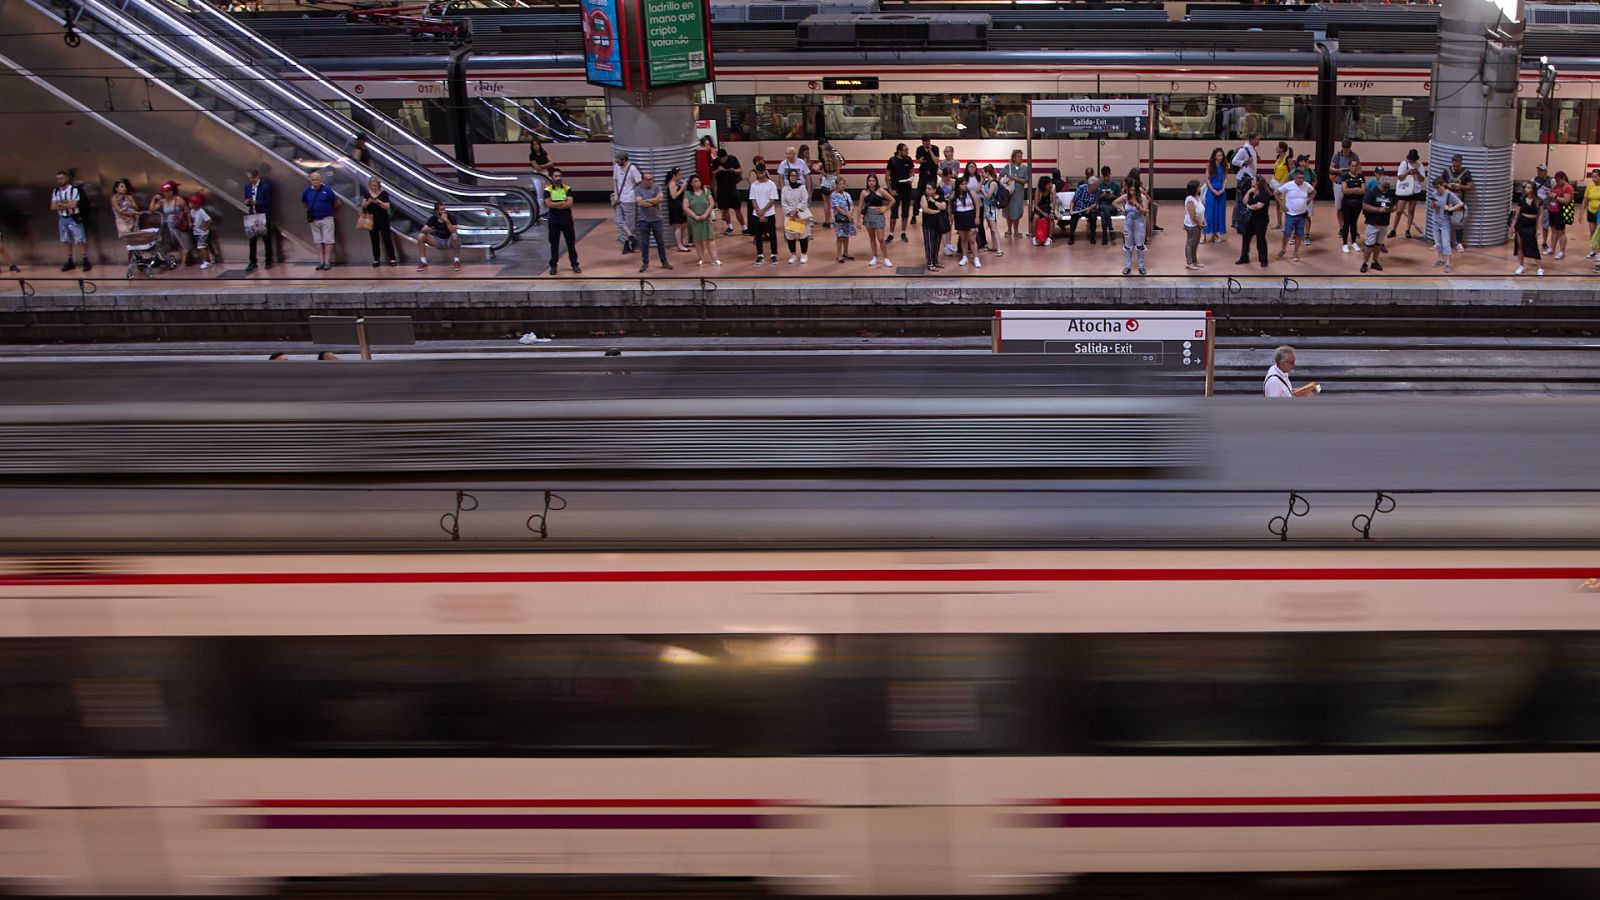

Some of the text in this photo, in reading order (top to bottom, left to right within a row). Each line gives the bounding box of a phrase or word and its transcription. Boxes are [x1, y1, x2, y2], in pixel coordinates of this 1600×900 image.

[648, 1, 694, 13] ladrillo en
[650, 13, 696, 24] mano que
[650, 26, 677, 36] cripto
[652, 35, 689, 47] volando
[474, 82, 504, 92] renfe
[1344, 79, 1374, 91] renfe
[1070, 104, 1101, 113] Atocha
[1068, 319, 1121, 332] Atocha
